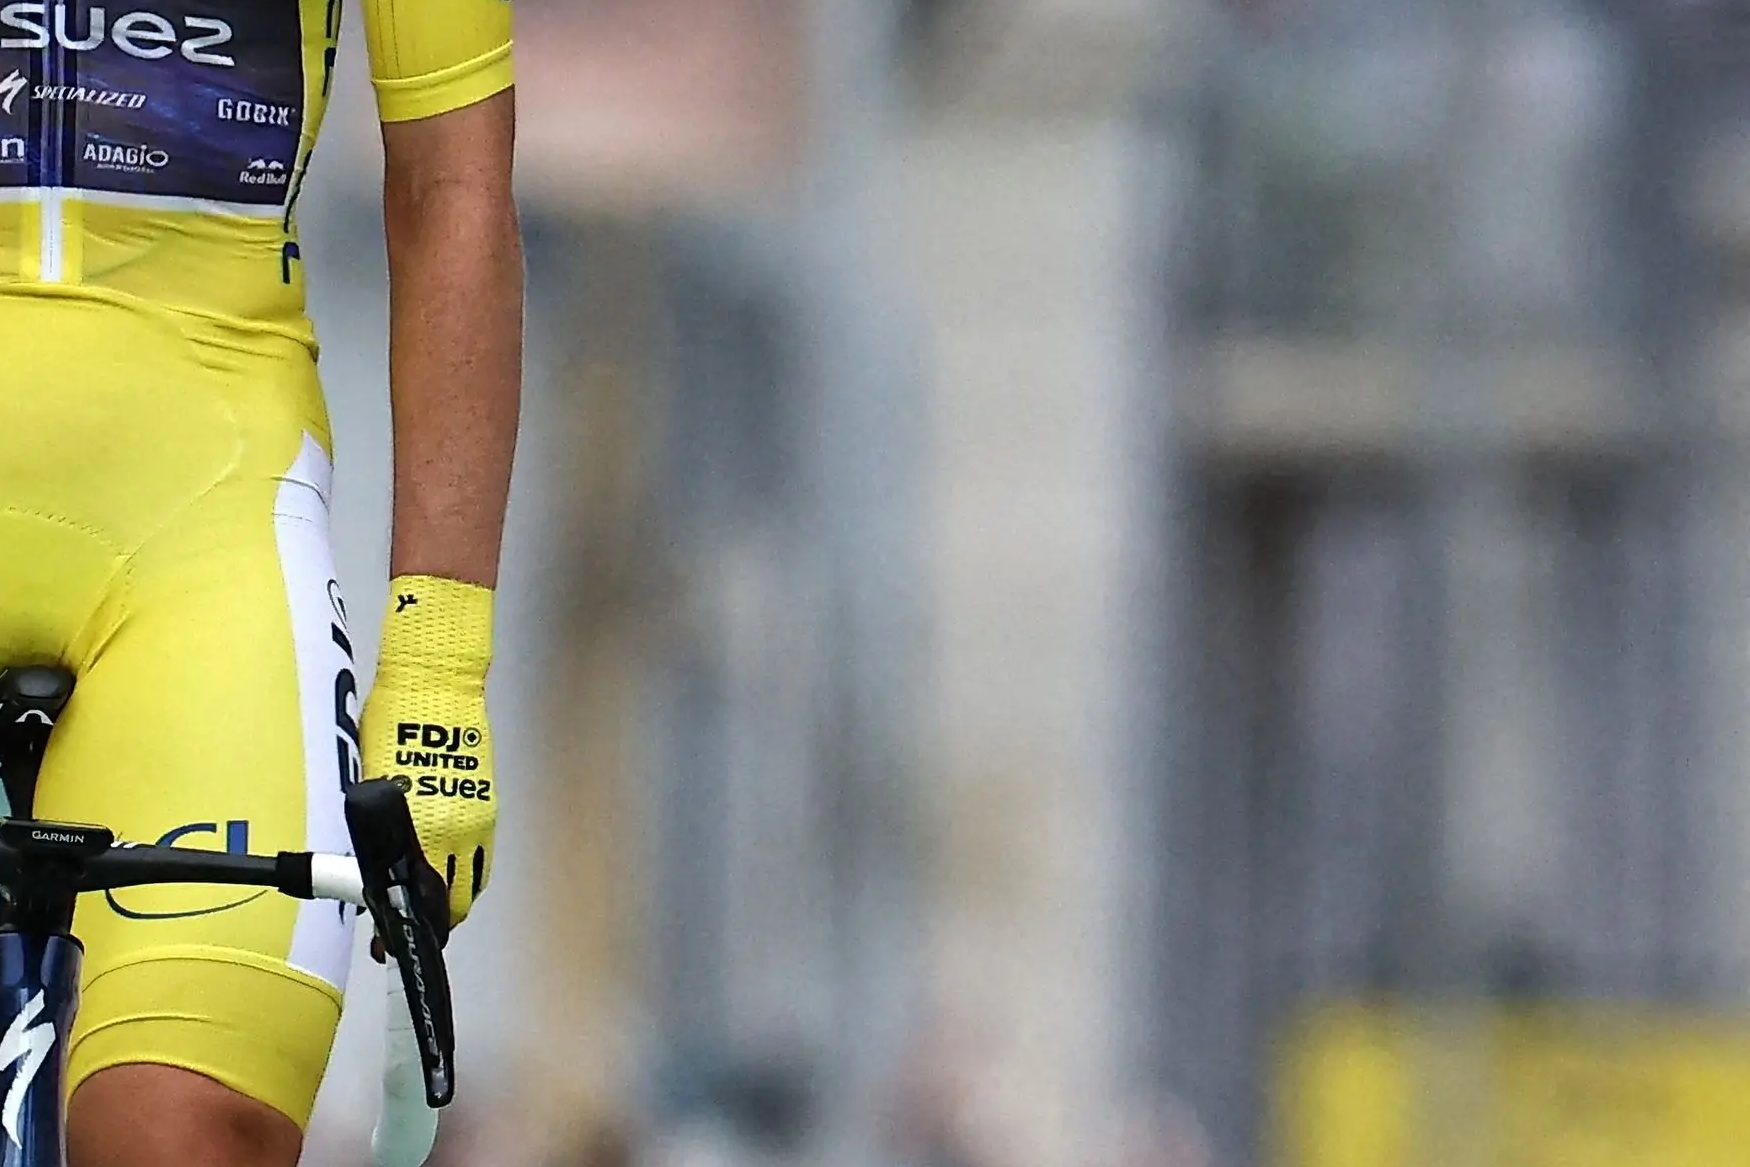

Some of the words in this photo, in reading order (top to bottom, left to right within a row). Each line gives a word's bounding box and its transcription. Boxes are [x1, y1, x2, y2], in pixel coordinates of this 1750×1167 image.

[32, 84, 147, 110] SPECIALIZED
[397, 722, 462, 753] FDJ
[396, 750, 479, 771] UNITED
[32, 830, 85, 844] GARMIN
